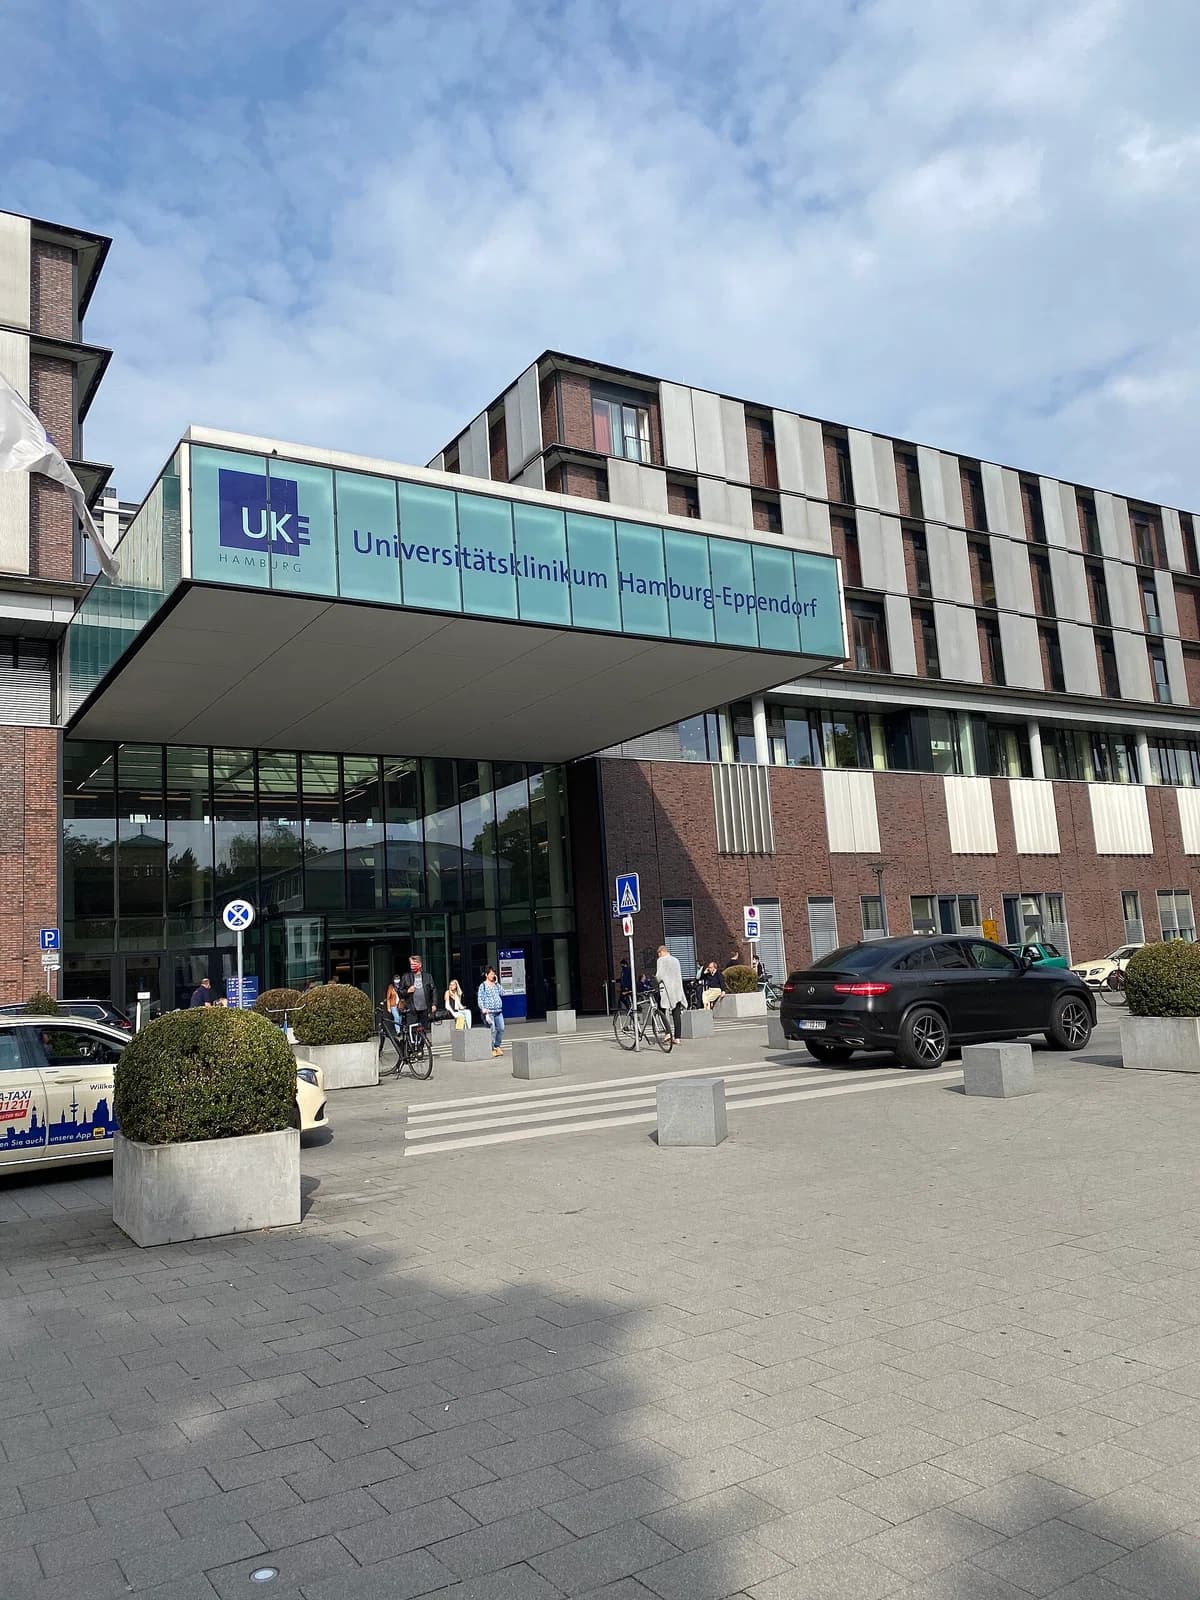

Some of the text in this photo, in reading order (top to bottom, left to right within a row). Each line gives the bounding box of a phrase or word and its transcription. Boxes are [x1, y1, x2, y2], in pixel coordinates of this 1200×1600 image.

[241, 506, 310, 546] UKE
[219, 552, 301, 573] HAMBURG
[353, 529, 818, 618] Universitätsklinikum Hamburg-Eppendorf
[45, 931, 55, 947] P
[25, 1136, 44, 1145] auch
[50, 1134, 74, 1142] unsere
[75, 1132, 92, 1142] App
